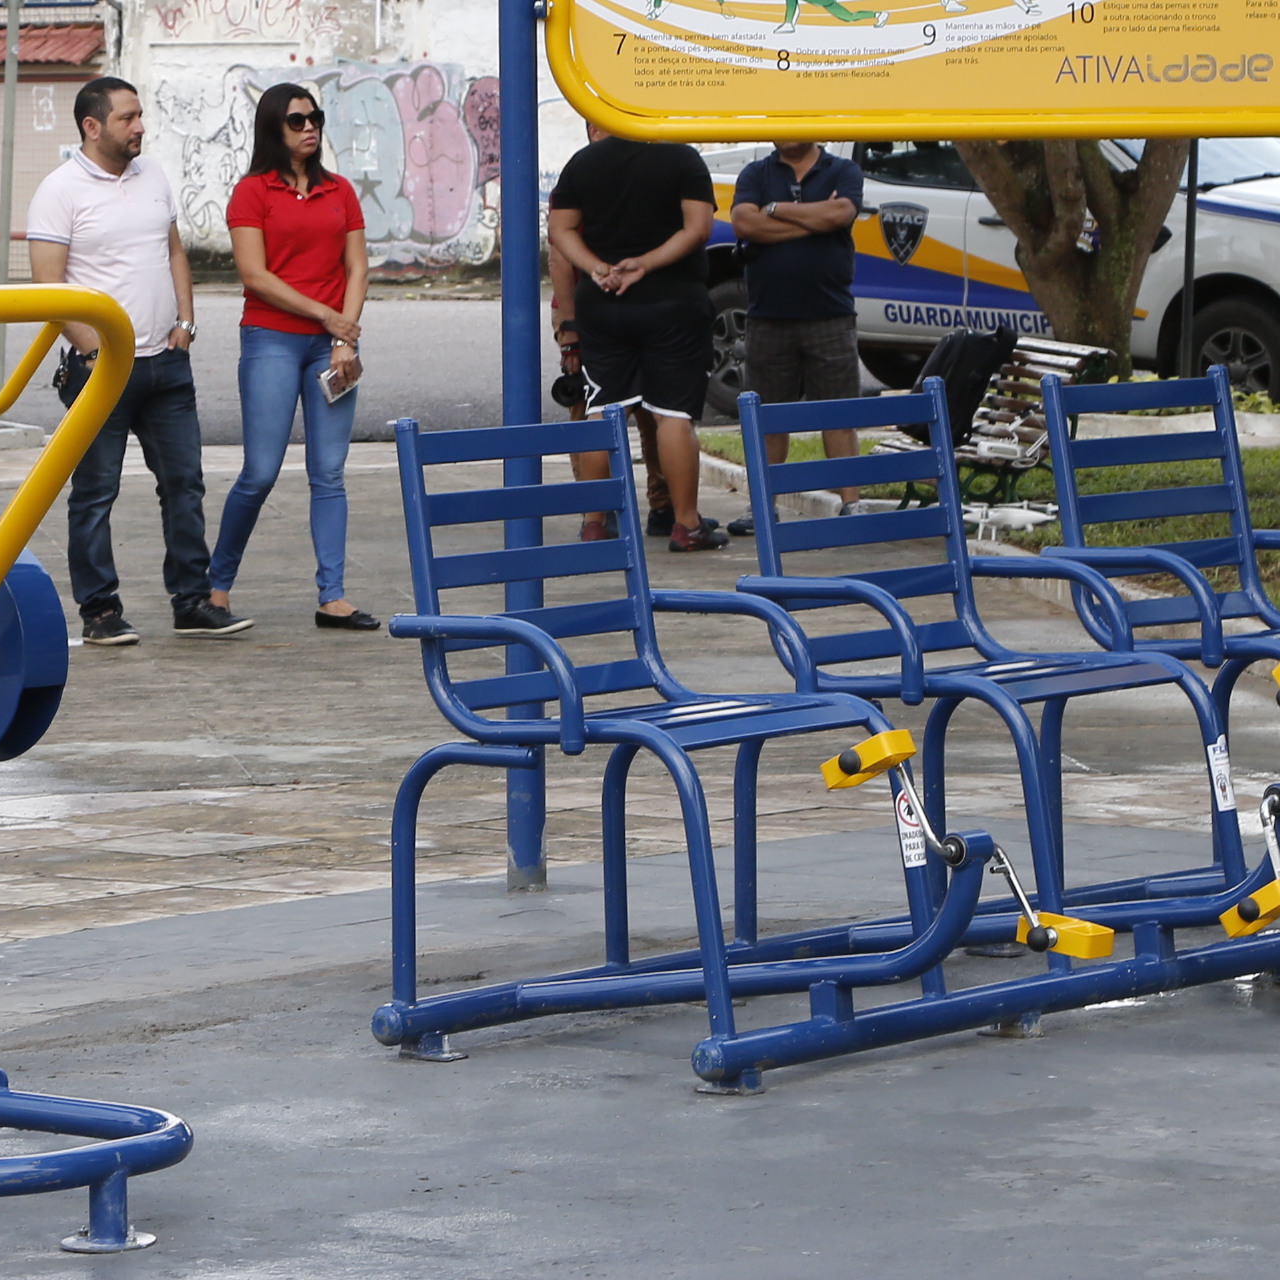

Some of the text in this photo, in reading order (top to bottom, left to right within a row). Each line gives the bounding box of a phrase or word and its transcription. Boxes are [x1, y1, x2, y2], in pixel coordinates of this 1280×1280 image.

[1067, 2, 1094, 24] 10
[1104, 3, 1129, 11] Estique
[1166, 3, 1190, 11] pernas
[923, 24, 936, 46] 9
[613, 34, 627, 55] 7
[688, 45, 701, 54] pés
[659, 57, 679, 65] desça
[777, 50, 790, 71] 8
[646, 81, 665, 89] parte
[883, 213, 924, 226] ATAC
[884, 303, 1052, 334] GUARDA MUNICIP
